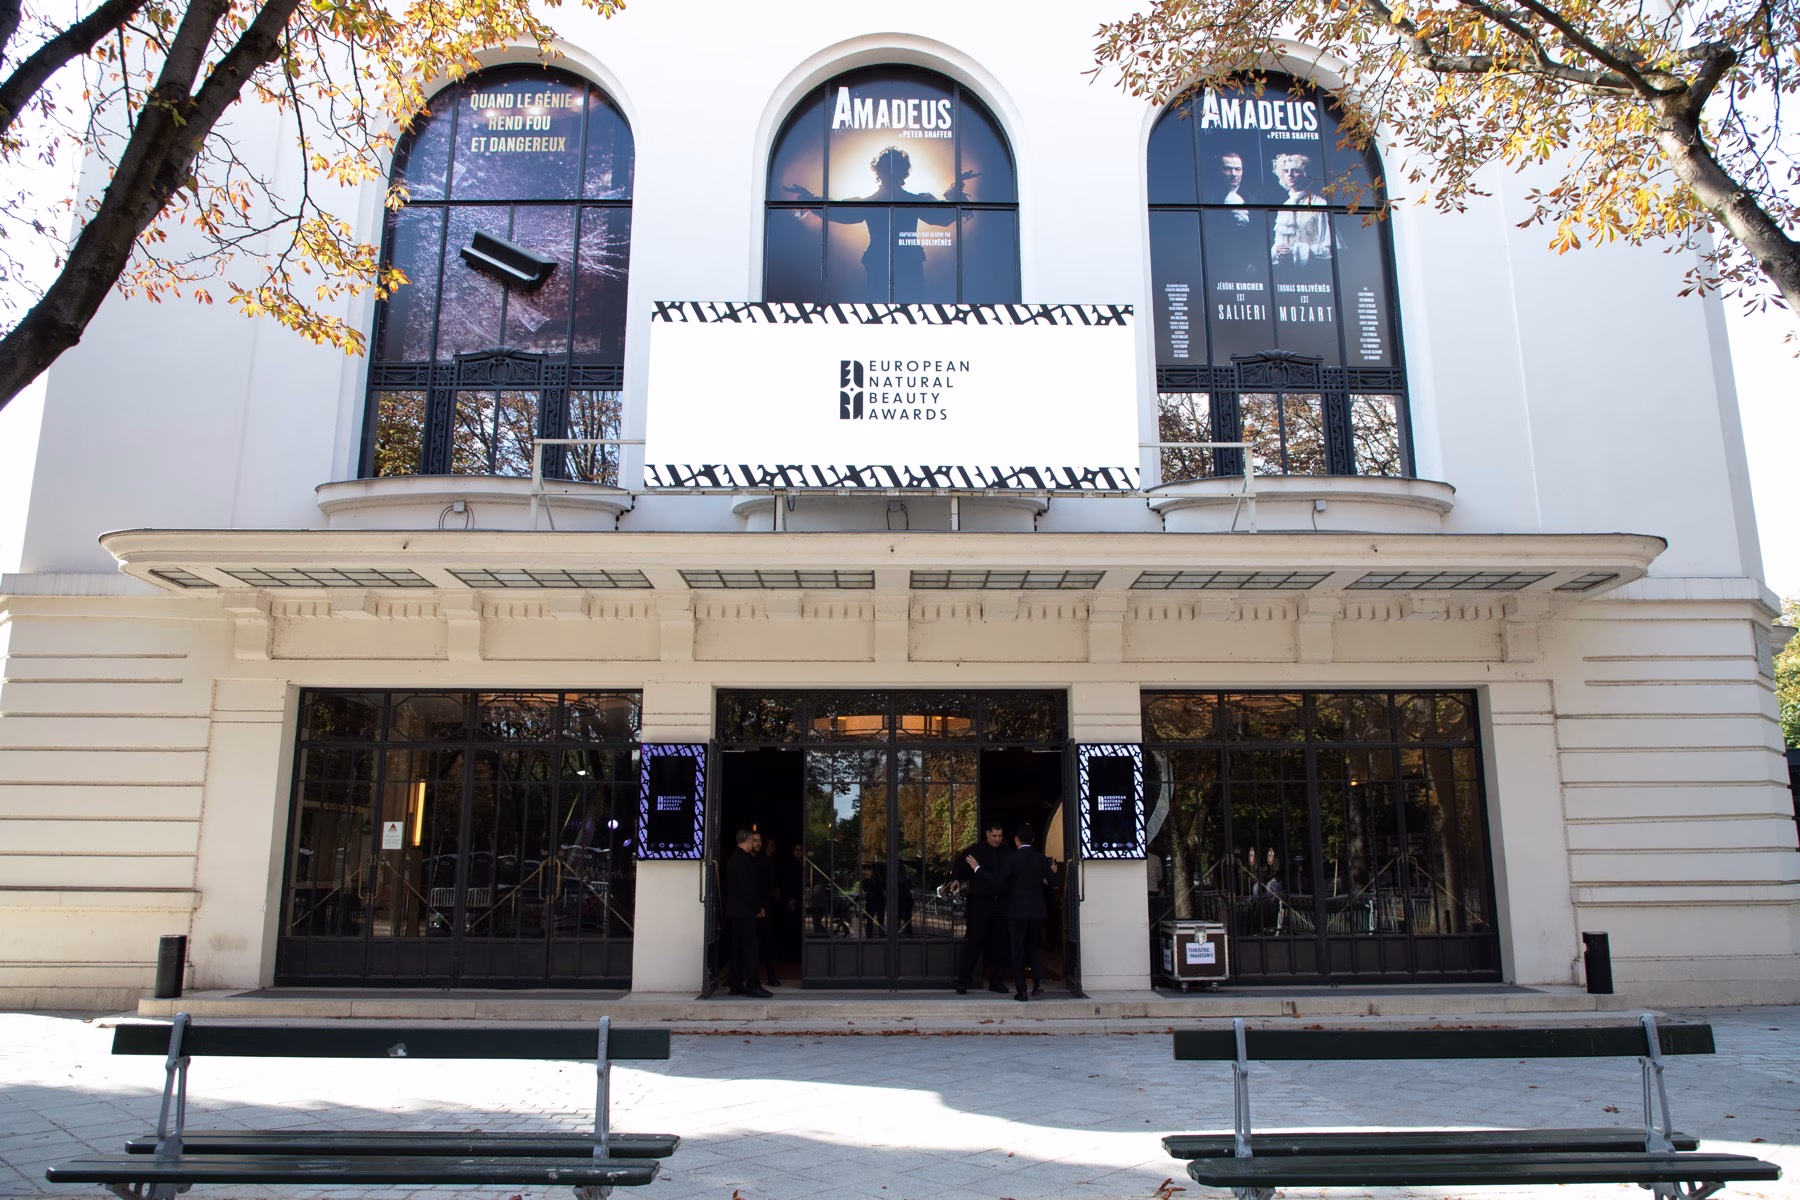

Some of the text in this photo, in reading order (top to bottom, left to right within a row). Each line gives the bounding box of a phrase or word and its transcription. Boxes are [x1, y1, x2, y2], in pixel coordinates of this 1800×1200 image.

[470, 91, 573, 110] QUAND LE GÉNIE
[832, 87, 952, 130] AMADEUS
[1201, 87, 1318, 131] AMADEUS
[488, 116, 551, 131] REND FOU
[902, 131, 923, 139] PETER
[924, 131, 952, 139] SHAFFER
[1291, 132, 1319, 140] SHAFFER
[471, 137, 566, 152] ET DANGEREUX
[1236, 282, 1264, 291] KIRCHER
[1277, 284, 1295, 292] THOMAS
[1300, 295, 1309, 303] EST
[1218, 304, 1266, 320] SALIERI
[1279, 306, 1332, 322] MOZART
[869, 360, 970, 372] EUROPEAN
[869, 376, 954, 388] NATURAL
[869, 392, 940, 404] BEAUTY
[868, 408, 948, 420] AWARDS
